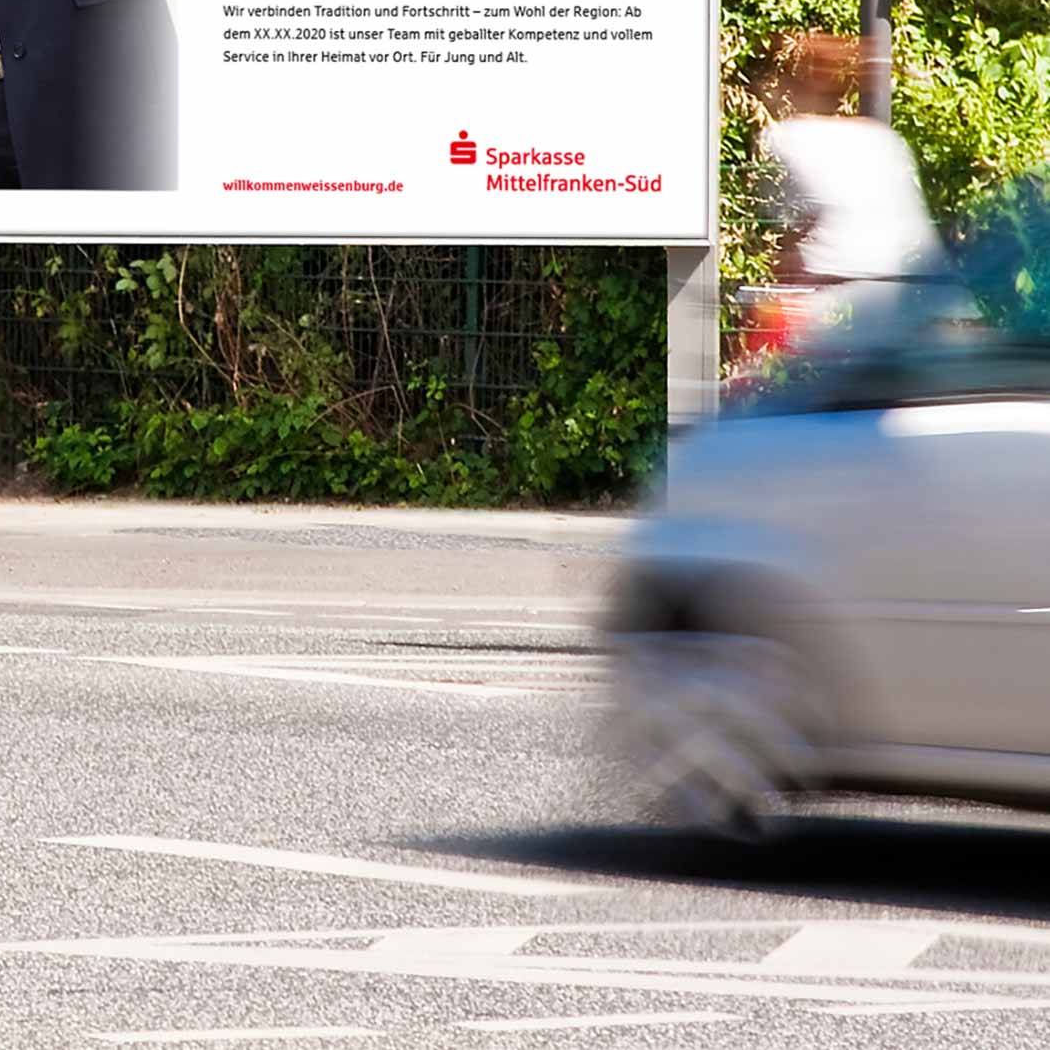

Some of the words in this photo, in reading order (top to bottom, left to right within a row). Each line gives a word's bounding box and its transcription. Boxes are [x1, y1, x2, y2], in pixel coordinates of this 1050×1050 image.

[222, 5, 245, 17] Wir
[247, 5, 311, 18] verbinden
[313, 4, 371, 18] Tradition
[374, 5, 399, 18] und
[401, 4, 471, 18] Fortschritt
[483, 7, 511, 18] zum
[513, 5, 546, 18] Wohl
[548, 5, 571, 18] der
[573, 5, 622, 21] Region:
[624, 5, 642, 18] Ab
[223, 27, 251, 40] dem
[253, 27, 327, 41] XX.XX.2020
[328, 28, 346, 41] ist
[348, 30, 385, 41] unser
[386, 27, 421, 41] Team
[424, 27, 446, 41] mit
[448, 27, 506, 43] geballter
[508, 28, 580, 43] Kompetenz
[583, 28, 608, 41] und
[610, 28, 653, 41] vollem
[222, 50, 270, 63] Service
[272, 50, 285, 63] in
[287, 50, 319, 63] Ihrer
[321, 50, 367, 63] Heimat
[368, 53, 390, 63] vor
[392, 50, 418, 63] Ort.
[420, 50, 442, 63] Für
[443, 51, 476, 66] Jung
[478, 51, 503, 63] und
[505, 50, 528, 63] Alt.
[486, 148, 585, 167] Sparkasse
[223, 180, 403, 194] willkommenweissenburg.de
[486, 174, 662, 193] Mittelfranken-Süd
